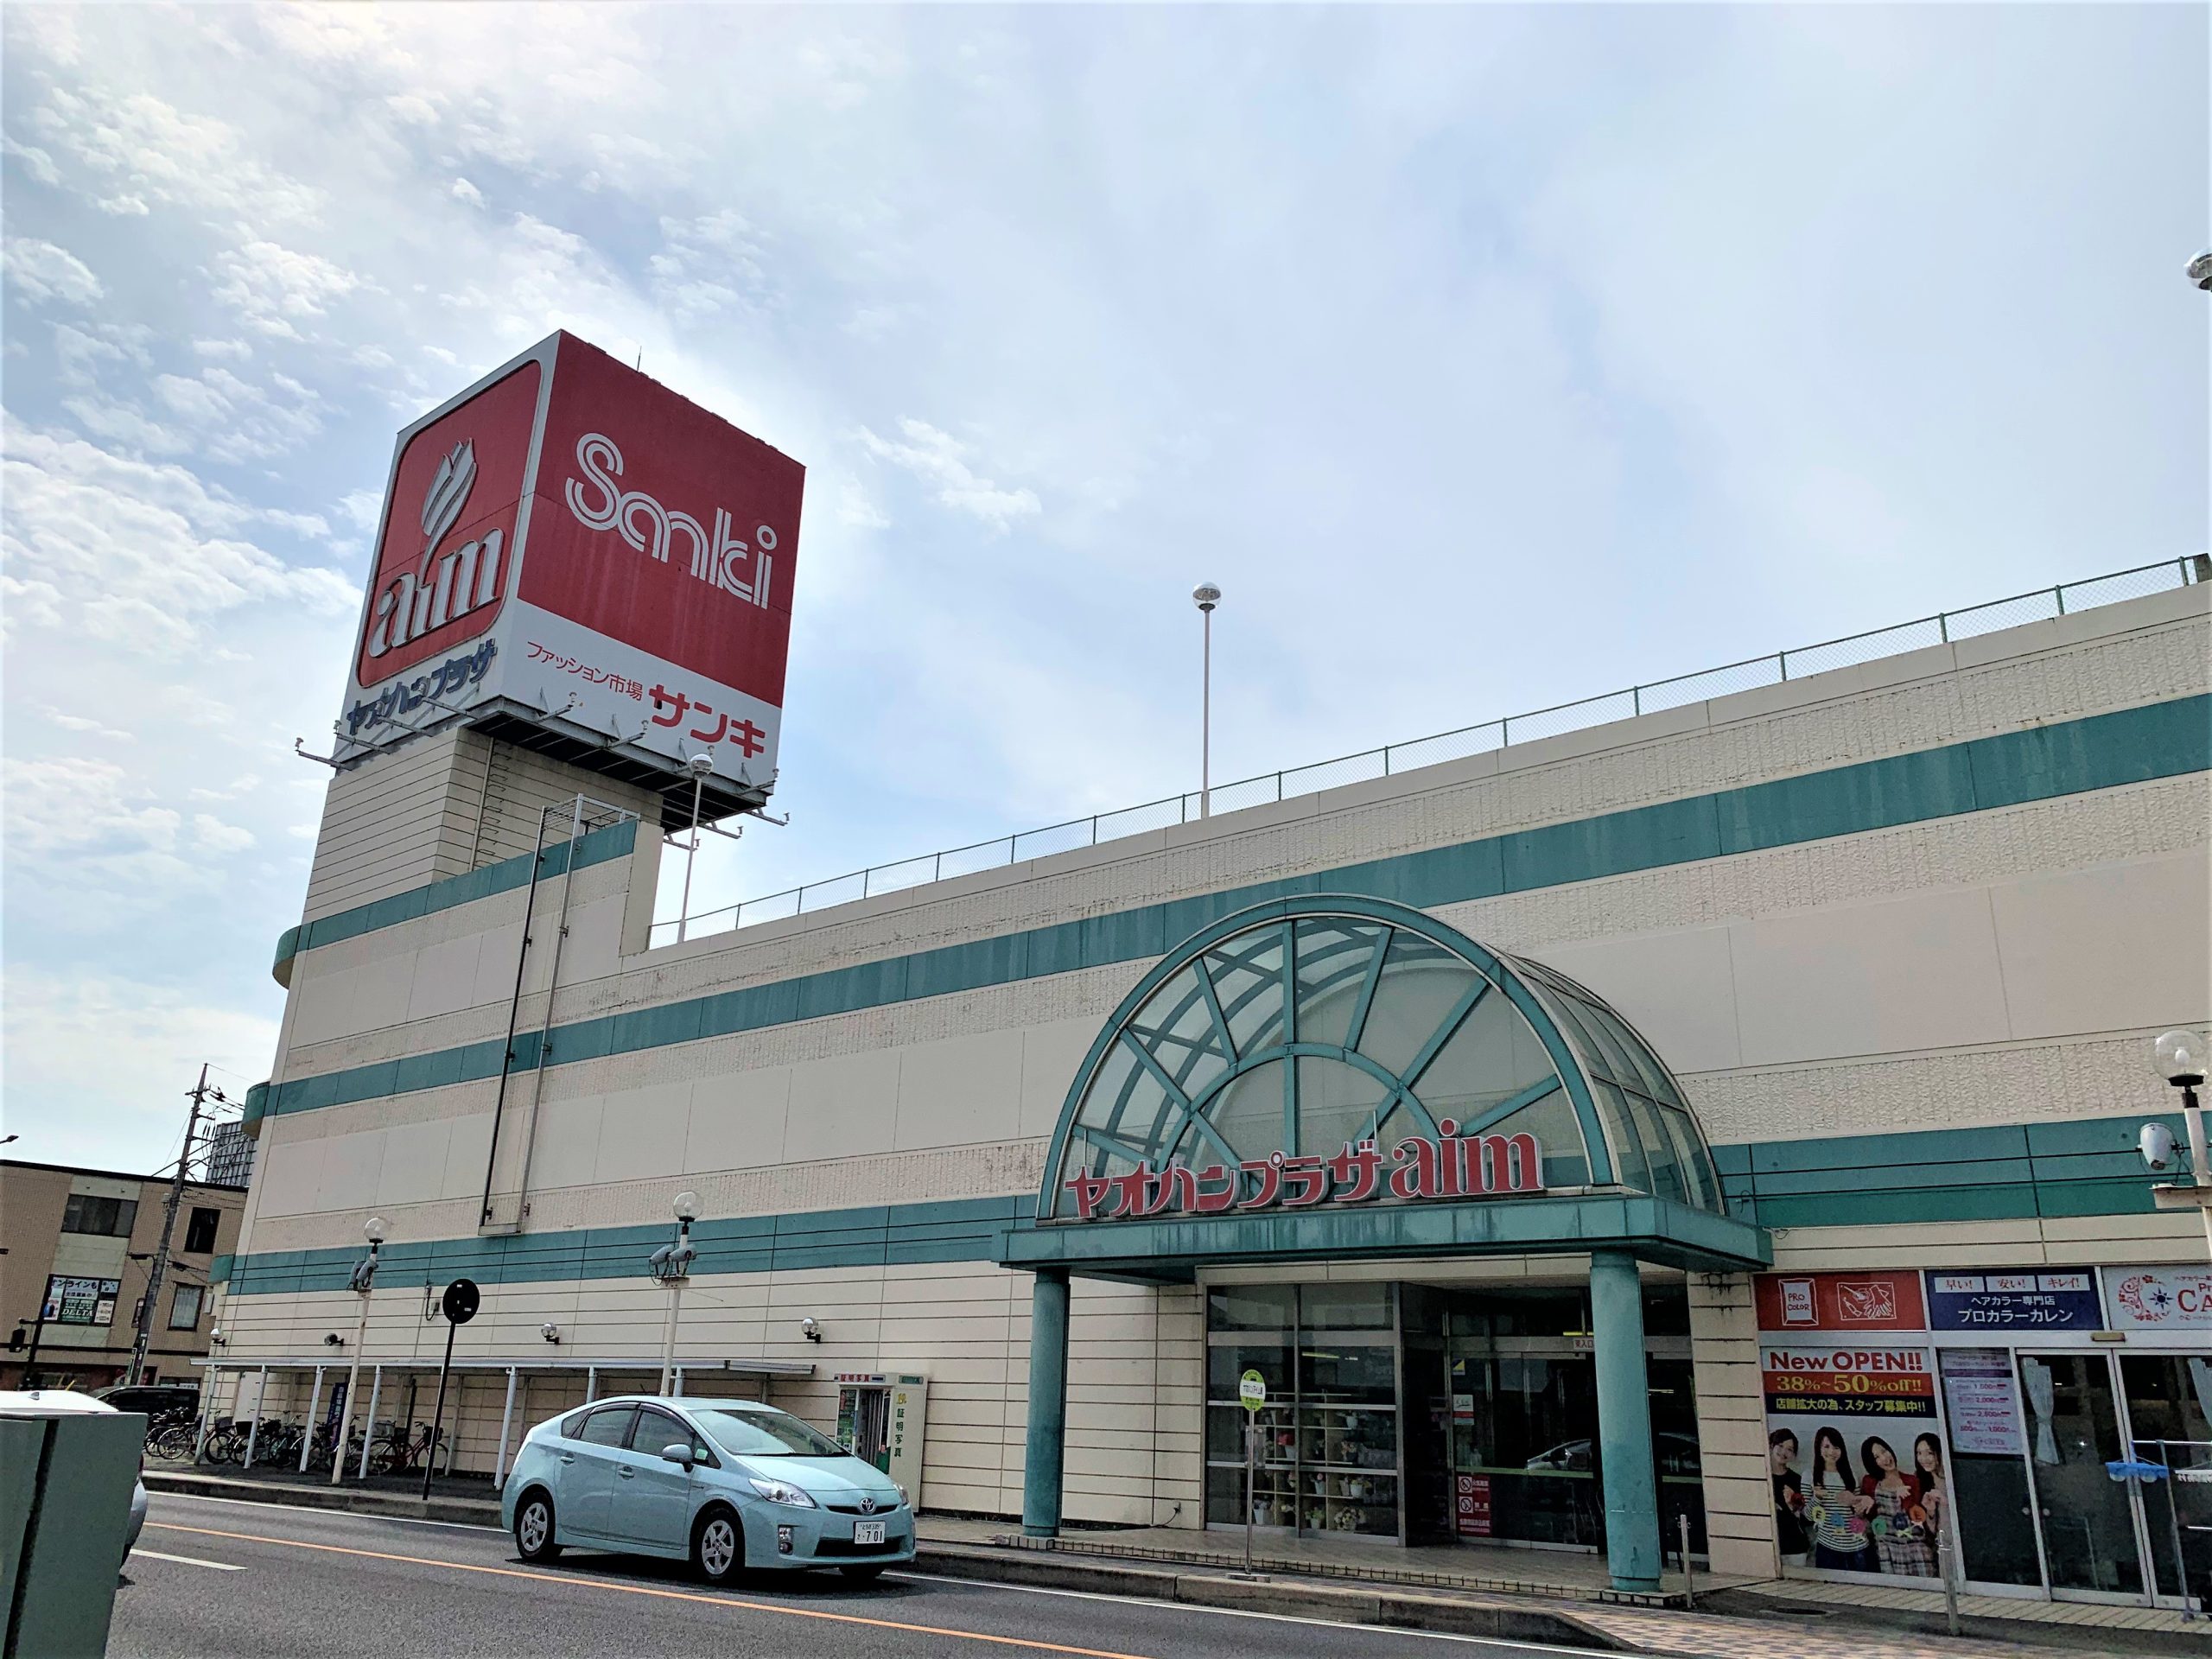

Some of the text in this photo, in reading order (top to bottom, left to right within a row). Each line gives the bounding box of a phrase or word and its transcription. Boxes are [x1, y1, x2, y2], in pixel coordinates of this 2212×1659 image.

[565, 433, 777, 609] Sanki
[368, 528, 505, 658] aim
[346, 638, 499, 734] ヤオハンプラザ
[527, 641, 766, 759] ファッション市場 サンキ
[1064, 1118, 1544, 1217] ヤオハンプラザ aim
[1788, 1293, 1805, 1301] PRO
[1958, 1308, 2073, 1323] プロカラーカレン
[1971, 1296, 2056, 1306] ヘアカラー専門店
[1770, 1351, 1923, 1371] New OPEN!!
